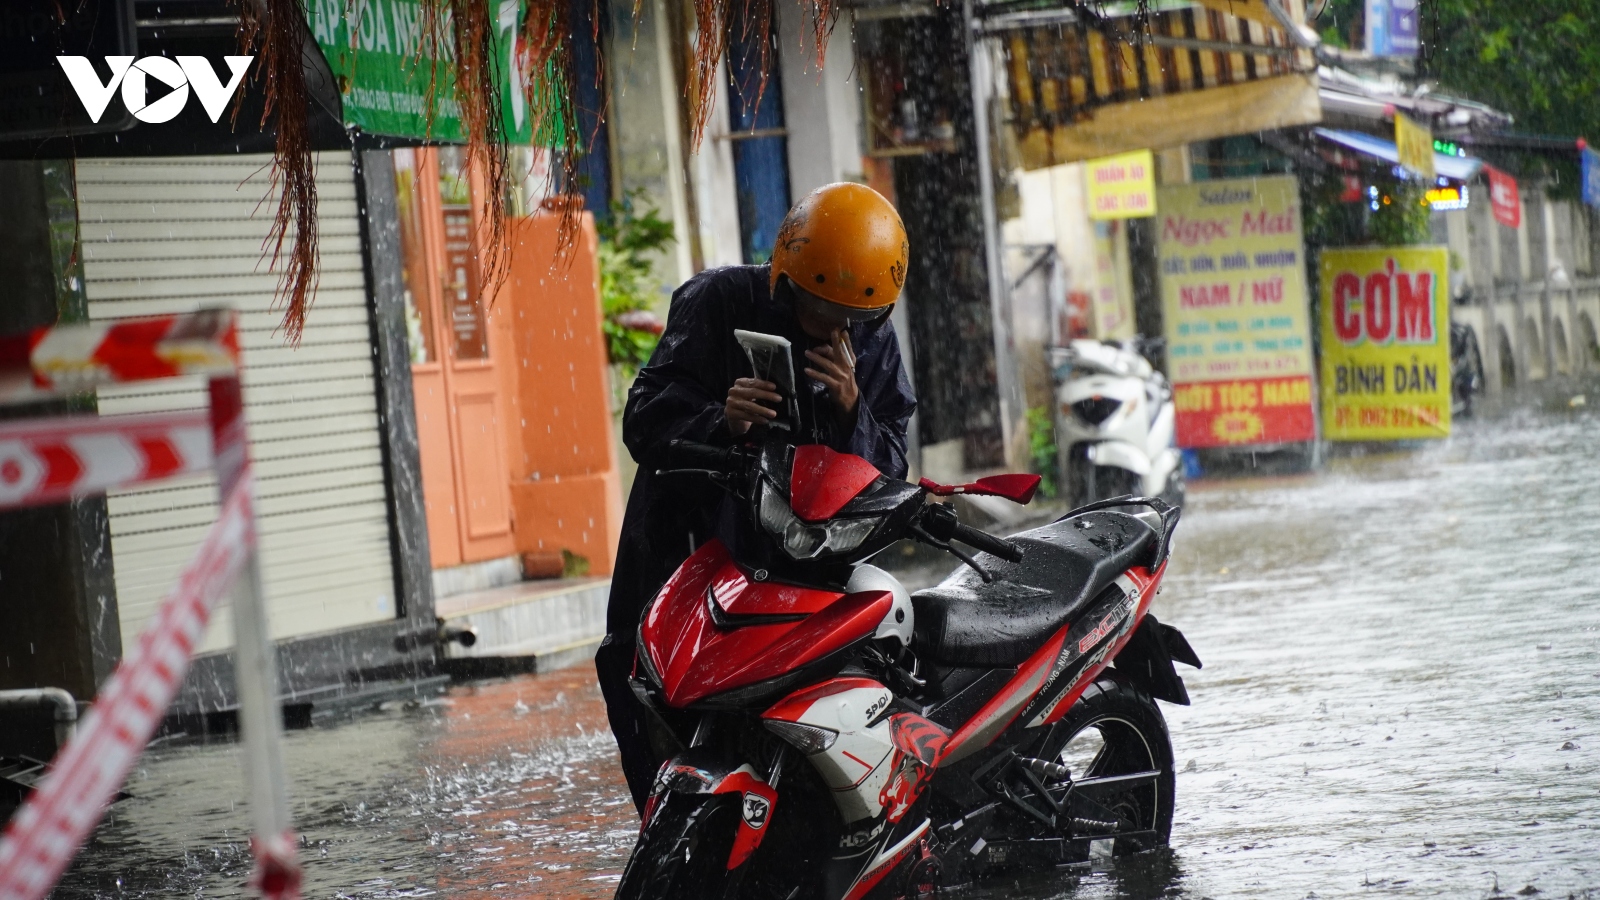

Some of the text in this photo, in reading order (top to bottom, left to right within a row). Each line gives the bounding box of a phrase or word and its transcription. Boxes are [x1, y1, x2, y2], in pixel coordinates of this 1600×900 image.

[1162, 206, 1294, 246] Ngọc Mai
[1180, 283, 1230, 307] NAM
[1333, 257, 1437, 346] CƠM
[1262, 379, 1310, 406] NAM
[1336, 354, 1437, 395] BÌNH DÂN
[1038, 670, 1060, 697] TRUNG
[1057, 648, 1071, 668] NAM
